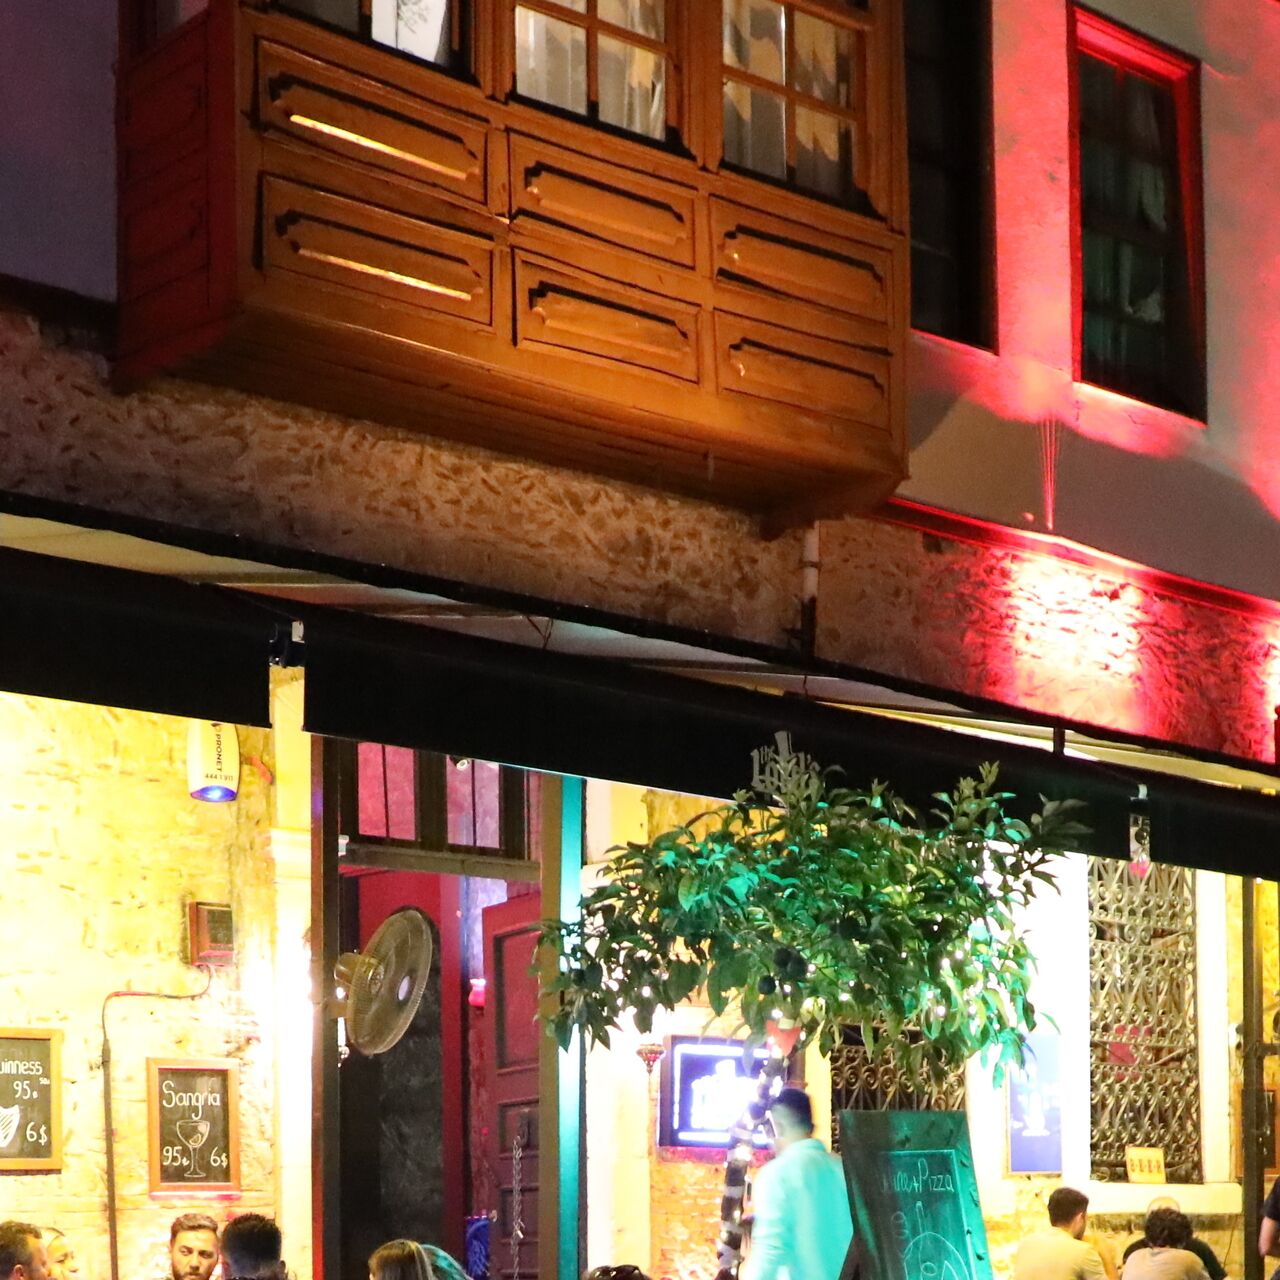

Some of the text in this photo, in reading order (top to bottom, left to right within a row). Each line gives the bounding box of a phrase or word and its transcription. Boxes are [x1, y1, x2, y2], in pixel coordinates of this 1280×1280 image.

[215, 733, 223, 772] PRONET
[162, 1080, 221, 1120] Sangria
[918, 1158, 955, 1193] Pizza
